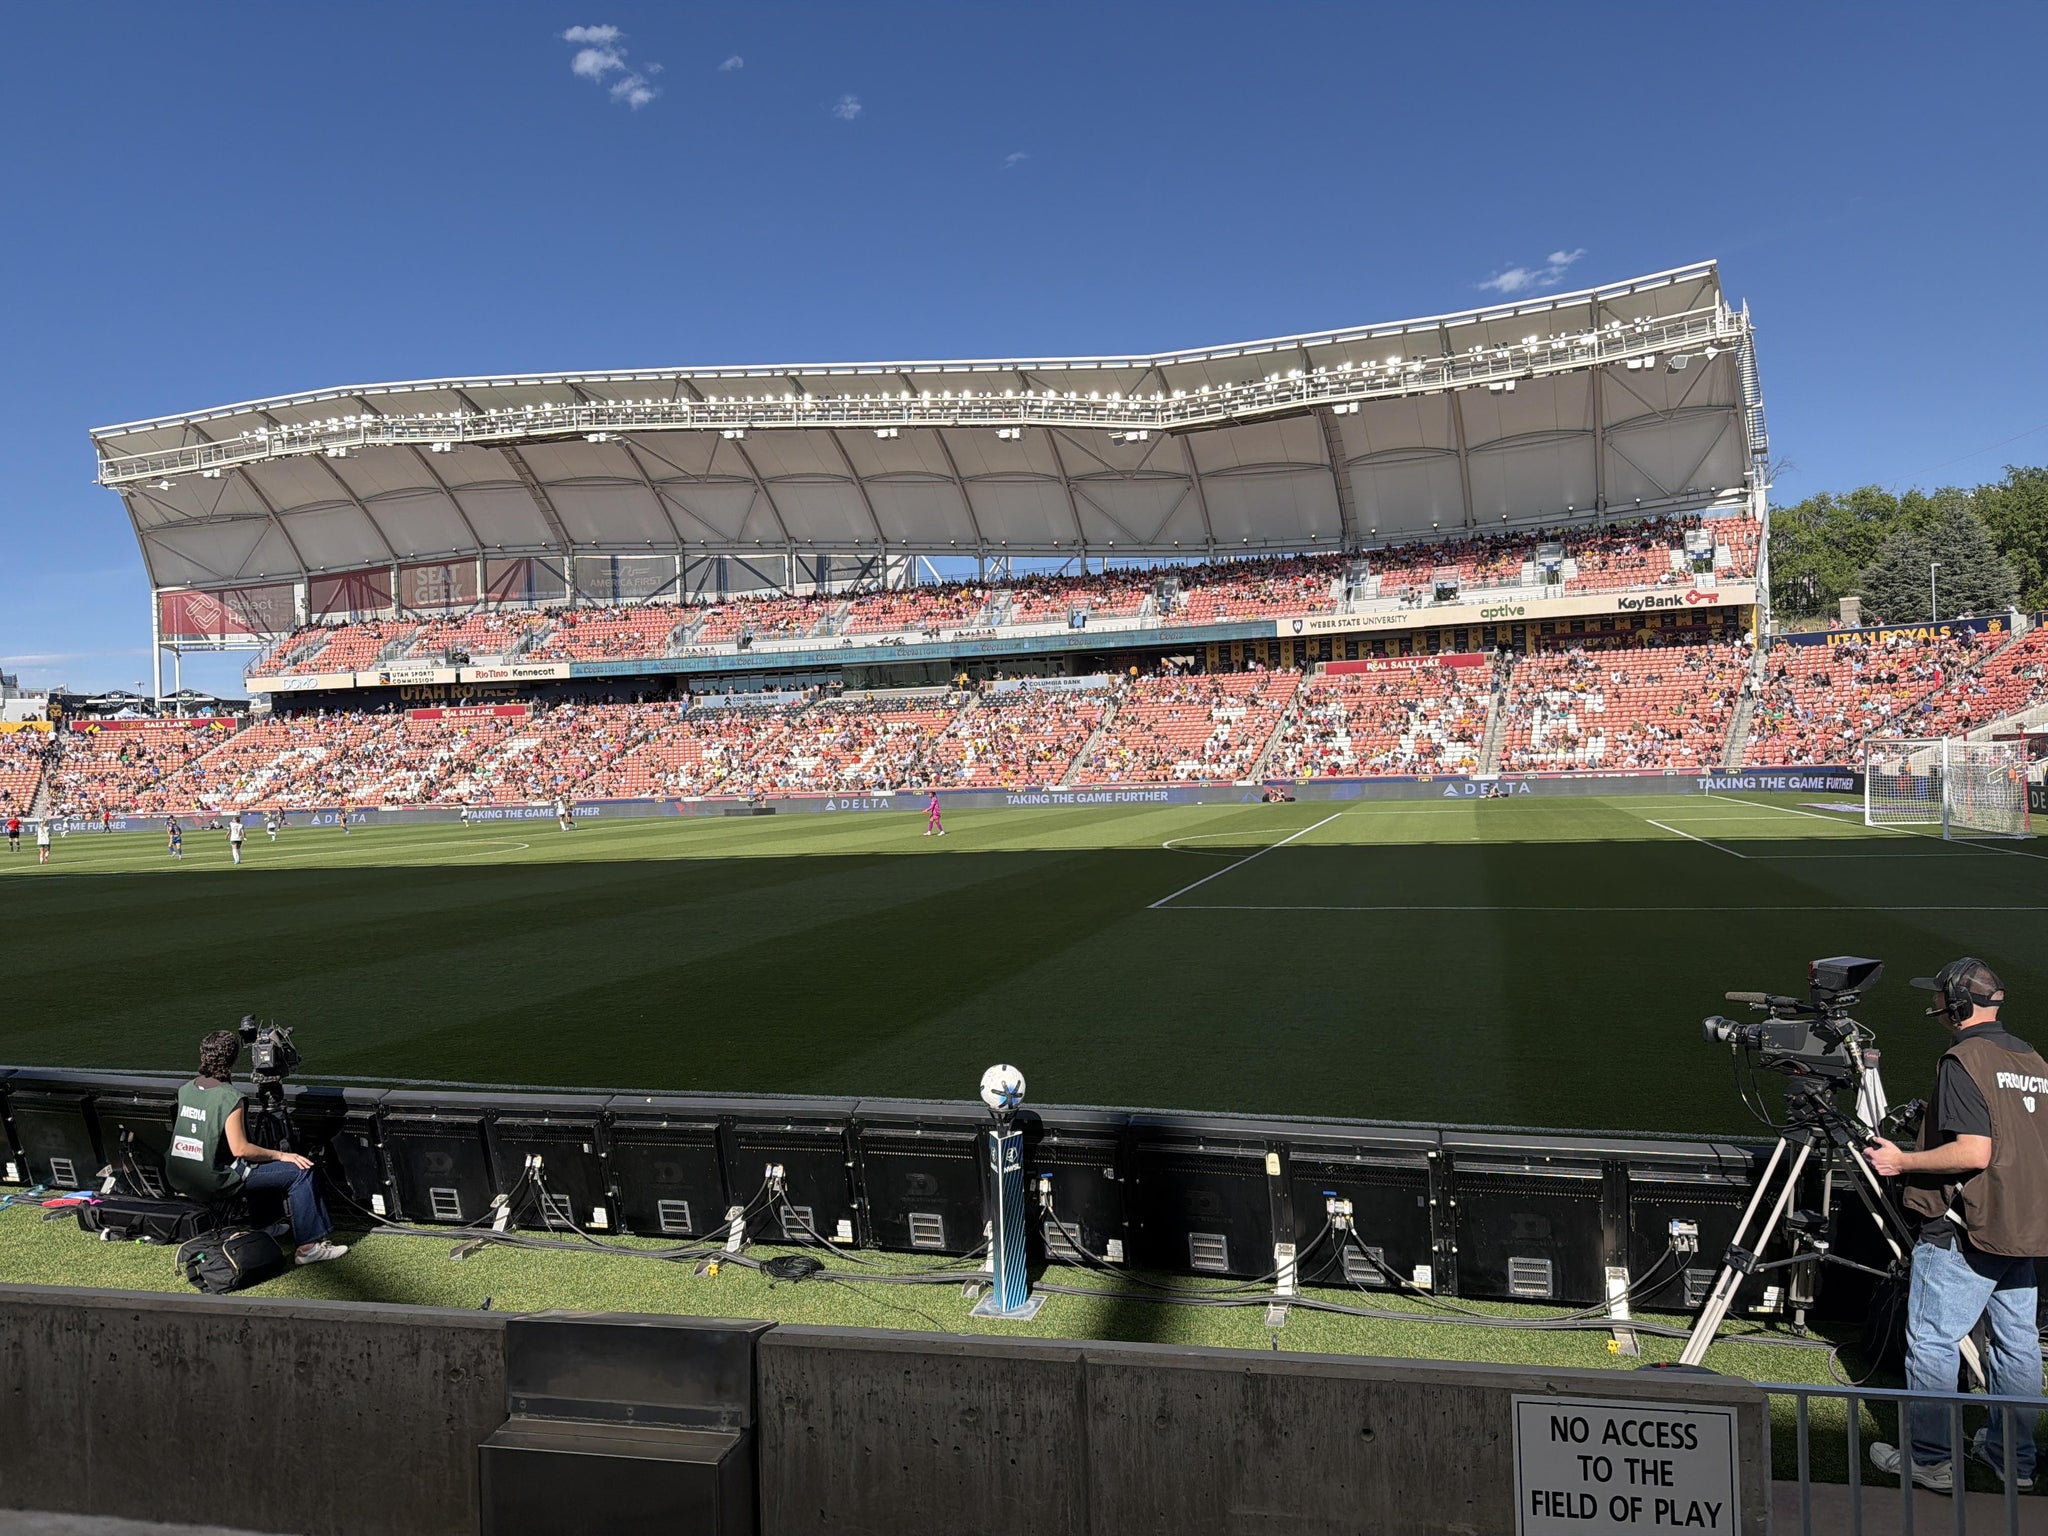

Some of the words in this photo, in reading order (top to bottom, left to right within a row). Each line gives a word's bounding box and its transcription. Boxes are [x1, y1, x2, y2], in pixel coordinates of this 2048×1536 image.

[416, 564, 460, 585] SEAT
[415, 584, 462, 604] GEEK
[228, 599, 273, 610] Select
[1617, 594, 1683, 612] KeyBank
[228, 612, 271, 624] Health
[1480, 604, 1525, 620] aptive
[1310, 620, 1336, 629] WEBER
[1338, 618, 1361, 627] STATE
[1362, 615, 1408, 625] UNIVERSITY
[1827, 631, 1876, 646] UTAH
[1879, 625, 1952, 642] ROYALS
[1390, 660, 1413, 669] SALT
[1415, 659, 1441, 668] LAKE
[512, 668, 555, 676] Kennecott
[282, 677, 318, 690] DOMO
[400, 685, 446, 701] UTAH
[477, 708, 496, 716] LAKE
[144, 721, 166, 729] SALT
[167, 720, 192, 729] LAKE
[1697, 777, 1756, 790] TAKING
[1758, 777, 1786, 789] THE
[1788, 777, 1824, 790] GAME
[1826, 777, 1854, 790] FURTHER
[841, 798, 889, 809] DELTA
[1006, 794, 1050, 805] TAKING
[1052, 793, 1075, 804] THE
[1076, 792, 1113, 803] GAME
[1115, 791, 1169, 803] FURTHER
[468, 809, 503, 819] TAKING
[504, 809, 523, 818] THE
[524, 808, 554, 818] GAME
[87, 821, 127, 831] FURHER
[2022, 1096, 2036, 1113] 10
[191, 1123, 197, 1134] 5
[175, 1141, 203, 1153] Canon
[1550, 1415, 1590, 1443] NO
[1601, 1418, 1698, 1450] ACCESS
[1576, 1454, 1613, 1483] TO
[1623, 1457, 1674, 1487] THE
[1531, 1489, 1598, 1520] FIELD
[1608, 1495, 1643, 1523] OF
[1654, 1498, 1723, 1529] PLAY
